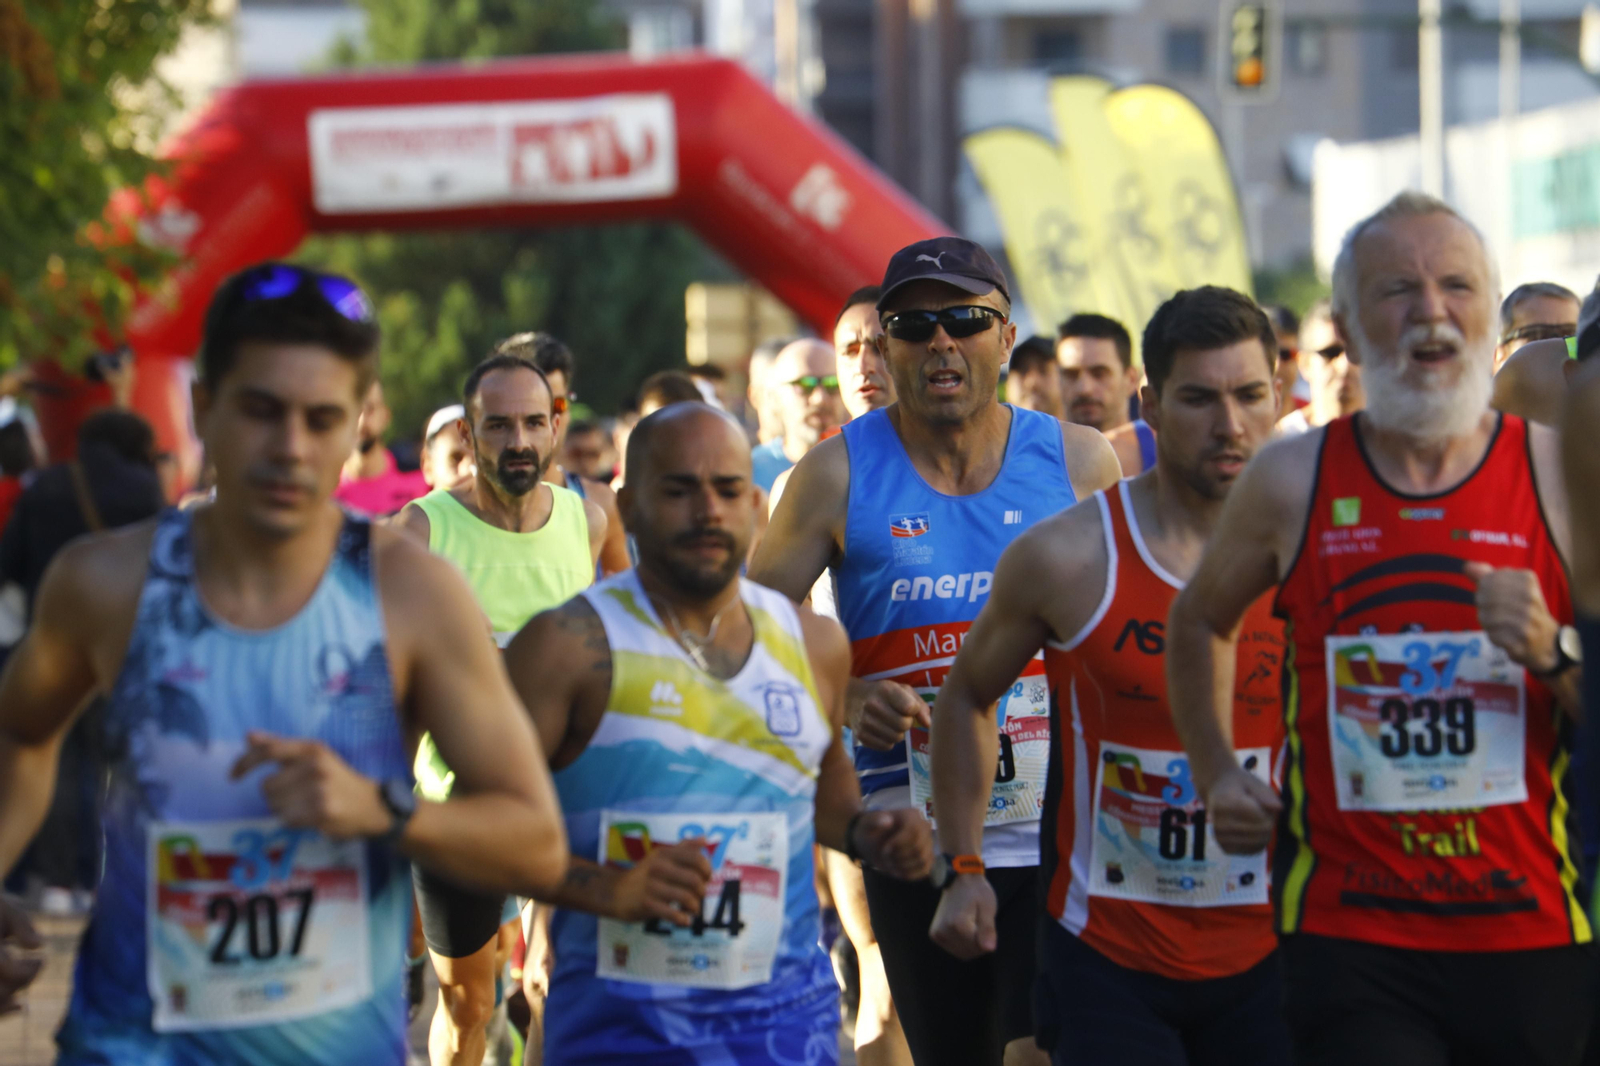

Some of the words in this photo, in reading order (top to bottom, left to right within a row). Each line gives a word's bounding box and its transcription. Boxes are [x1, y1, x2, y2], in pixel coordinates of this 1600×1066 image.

[1380, 696, 1475, 758] 339
[1159, 807, 1206, 862] 61
[1390, 818, 1481, 857] Trail
[206, 884, 315, 964] 207
[644, 879, 746, 938] 44
